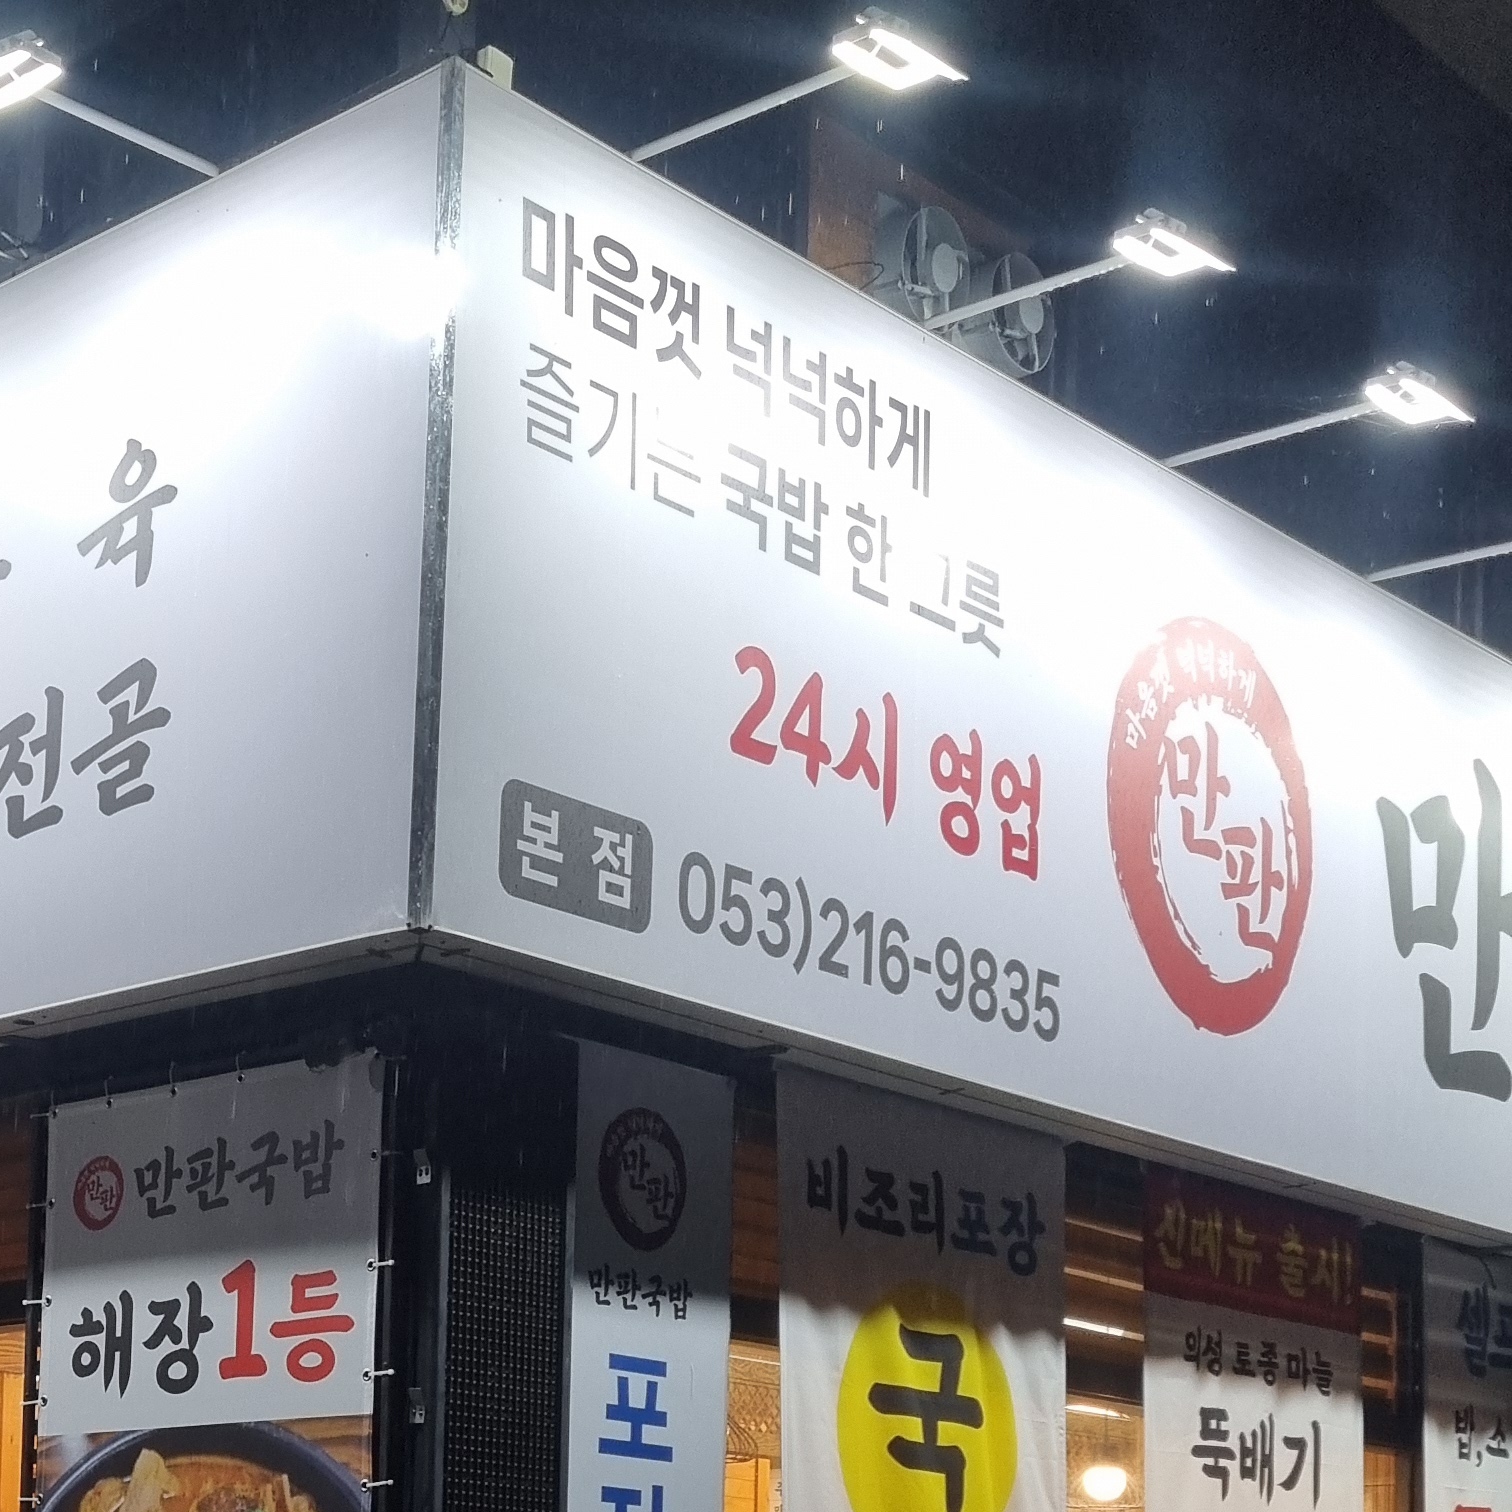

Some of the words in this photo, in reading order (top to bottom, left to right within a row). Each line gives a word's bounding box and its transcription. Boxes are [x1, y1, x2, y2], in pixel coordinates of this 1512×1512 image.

[521, 196, 703, 381] 마음껏
[725, 304, 932, 499] 넉넉하게
[519, 342, 702, 519] 즐기는
[719, 442, 830, 577] 국밥
[845, 501, 893, 608] 한
[909, 553, 1005, 659] 그릇
[728, 645, 898, 827] 24시
[928, 728, 1042, 882] 영업
[1163, 720, 1286, 951] 만판
[678, 850, 1062, 1043] 053)216-9835
[133, 1118, 345, 1220] 만판국밥
[805, 1144, 1047, 1278] 비조리포장
[68, 1259, 356, 1400] 해장1등
[588, 1262, 694, 1321] 만판국밥
[1232, 1341, 1280, 1388] 토종
[1190, 1406, 1324, 1510] 뚝배기
